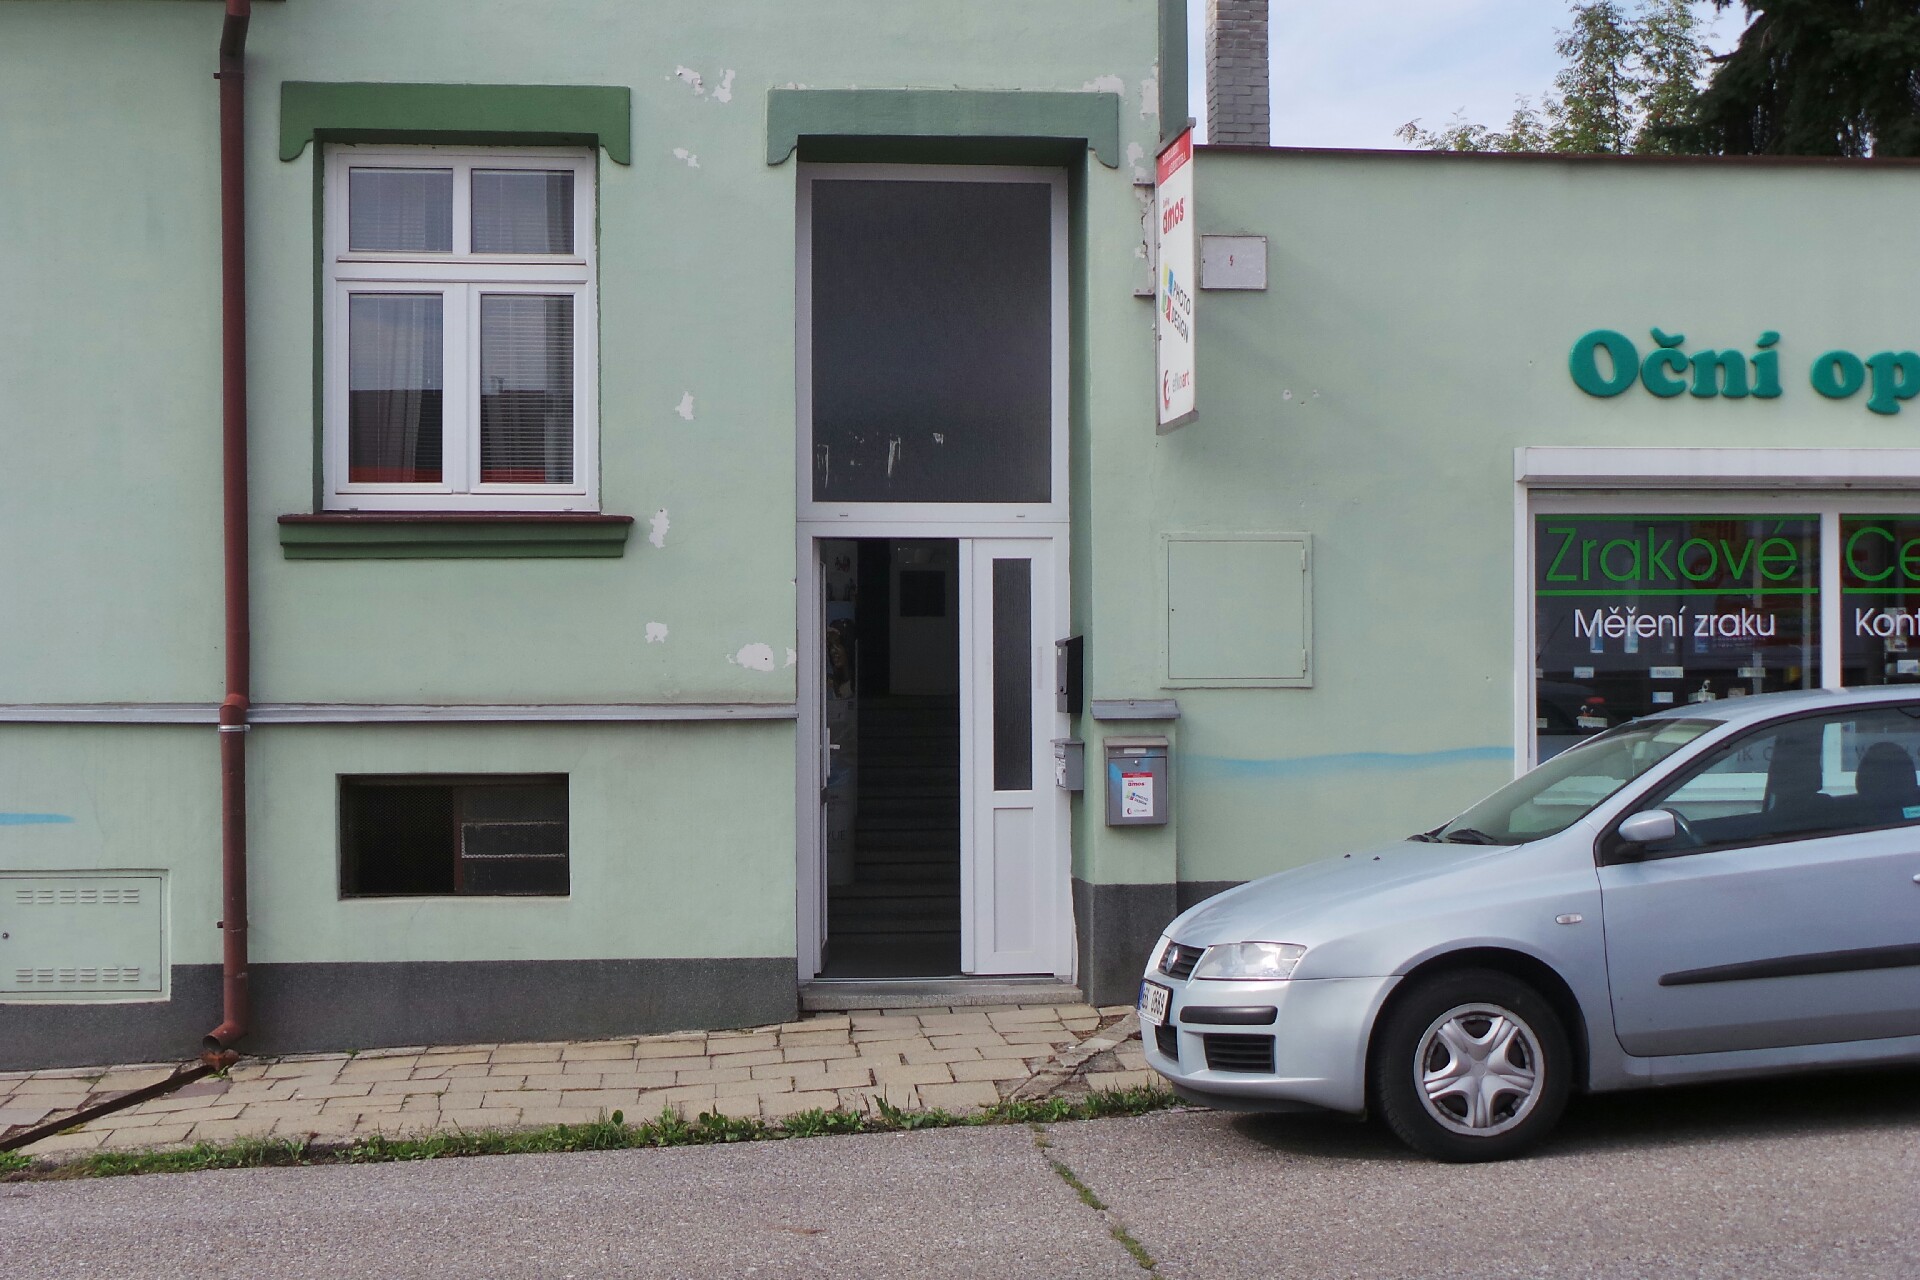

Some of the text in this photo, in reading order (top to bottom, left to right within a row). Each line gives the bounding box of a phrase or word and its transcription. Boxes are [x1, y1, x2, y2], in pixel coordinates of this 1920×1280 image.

[1163, 197, 1184, 235] amos
[1172, 279, 1191, 316] PHOTO
[1171, 306, 1189, 344] DESIGN
[1568, 327, 1920, 414] Oční op
[1546, 521, 1798, 582] Zrakové
[1574, 605, 1775, 638] Měření zraku
